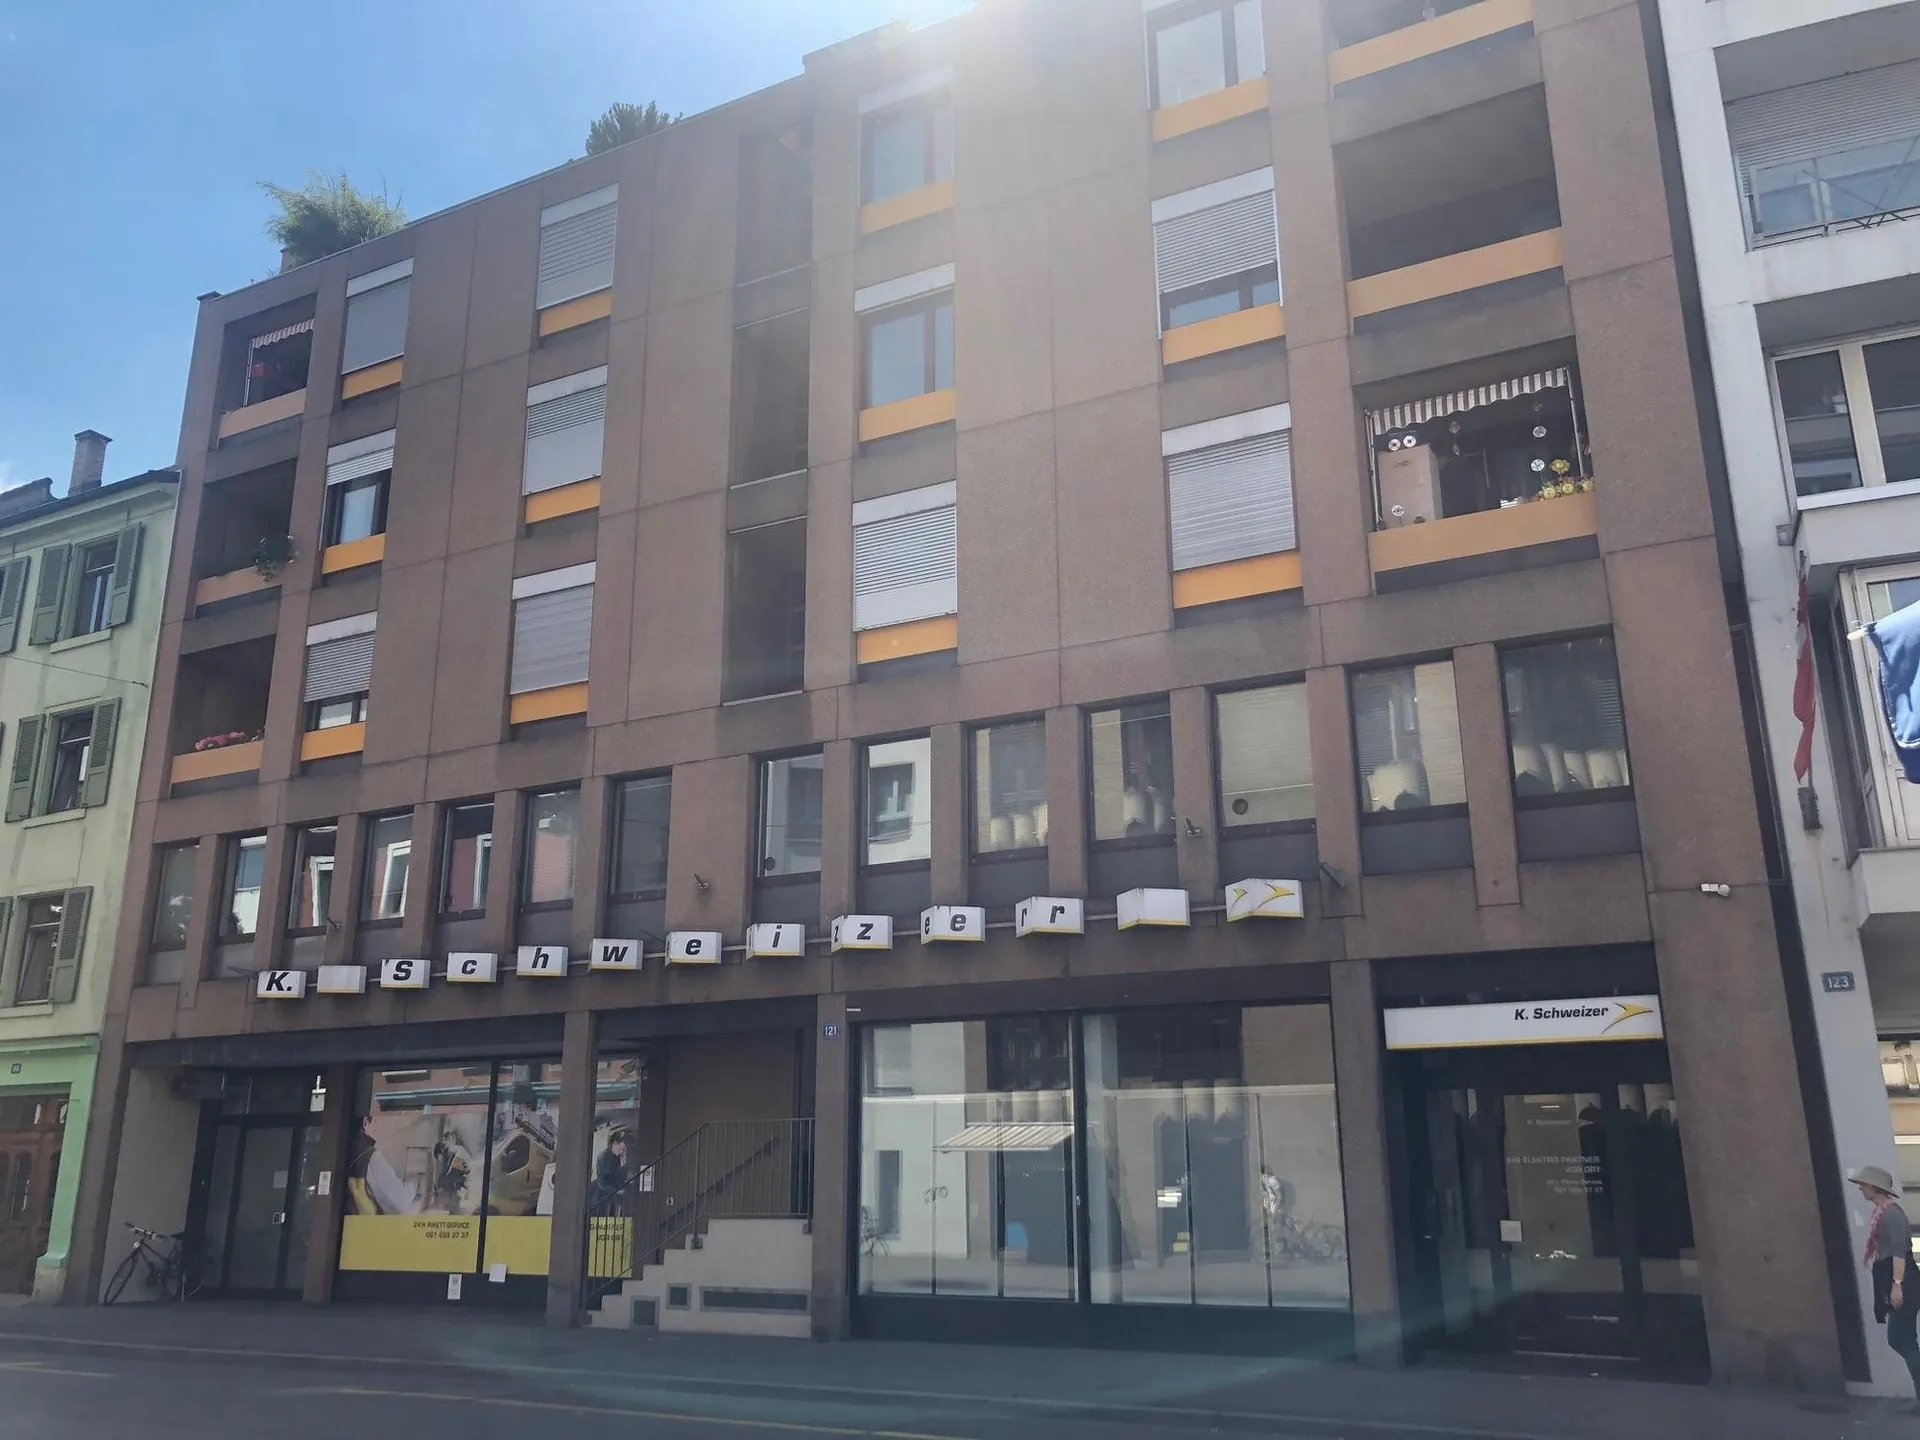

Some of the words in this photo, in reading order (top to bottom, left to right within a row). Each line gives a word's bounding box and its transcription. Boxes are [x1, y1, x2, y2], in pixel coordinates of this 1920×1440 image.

[265, 971, 293, 992] K.
[1827, 975, 1849, 989] 123
[1514, 1007, 1529, 1021] K.
[1532, 1004, 1610, 1020] Schweizer
[825, 1025, 837, 1037] 121
